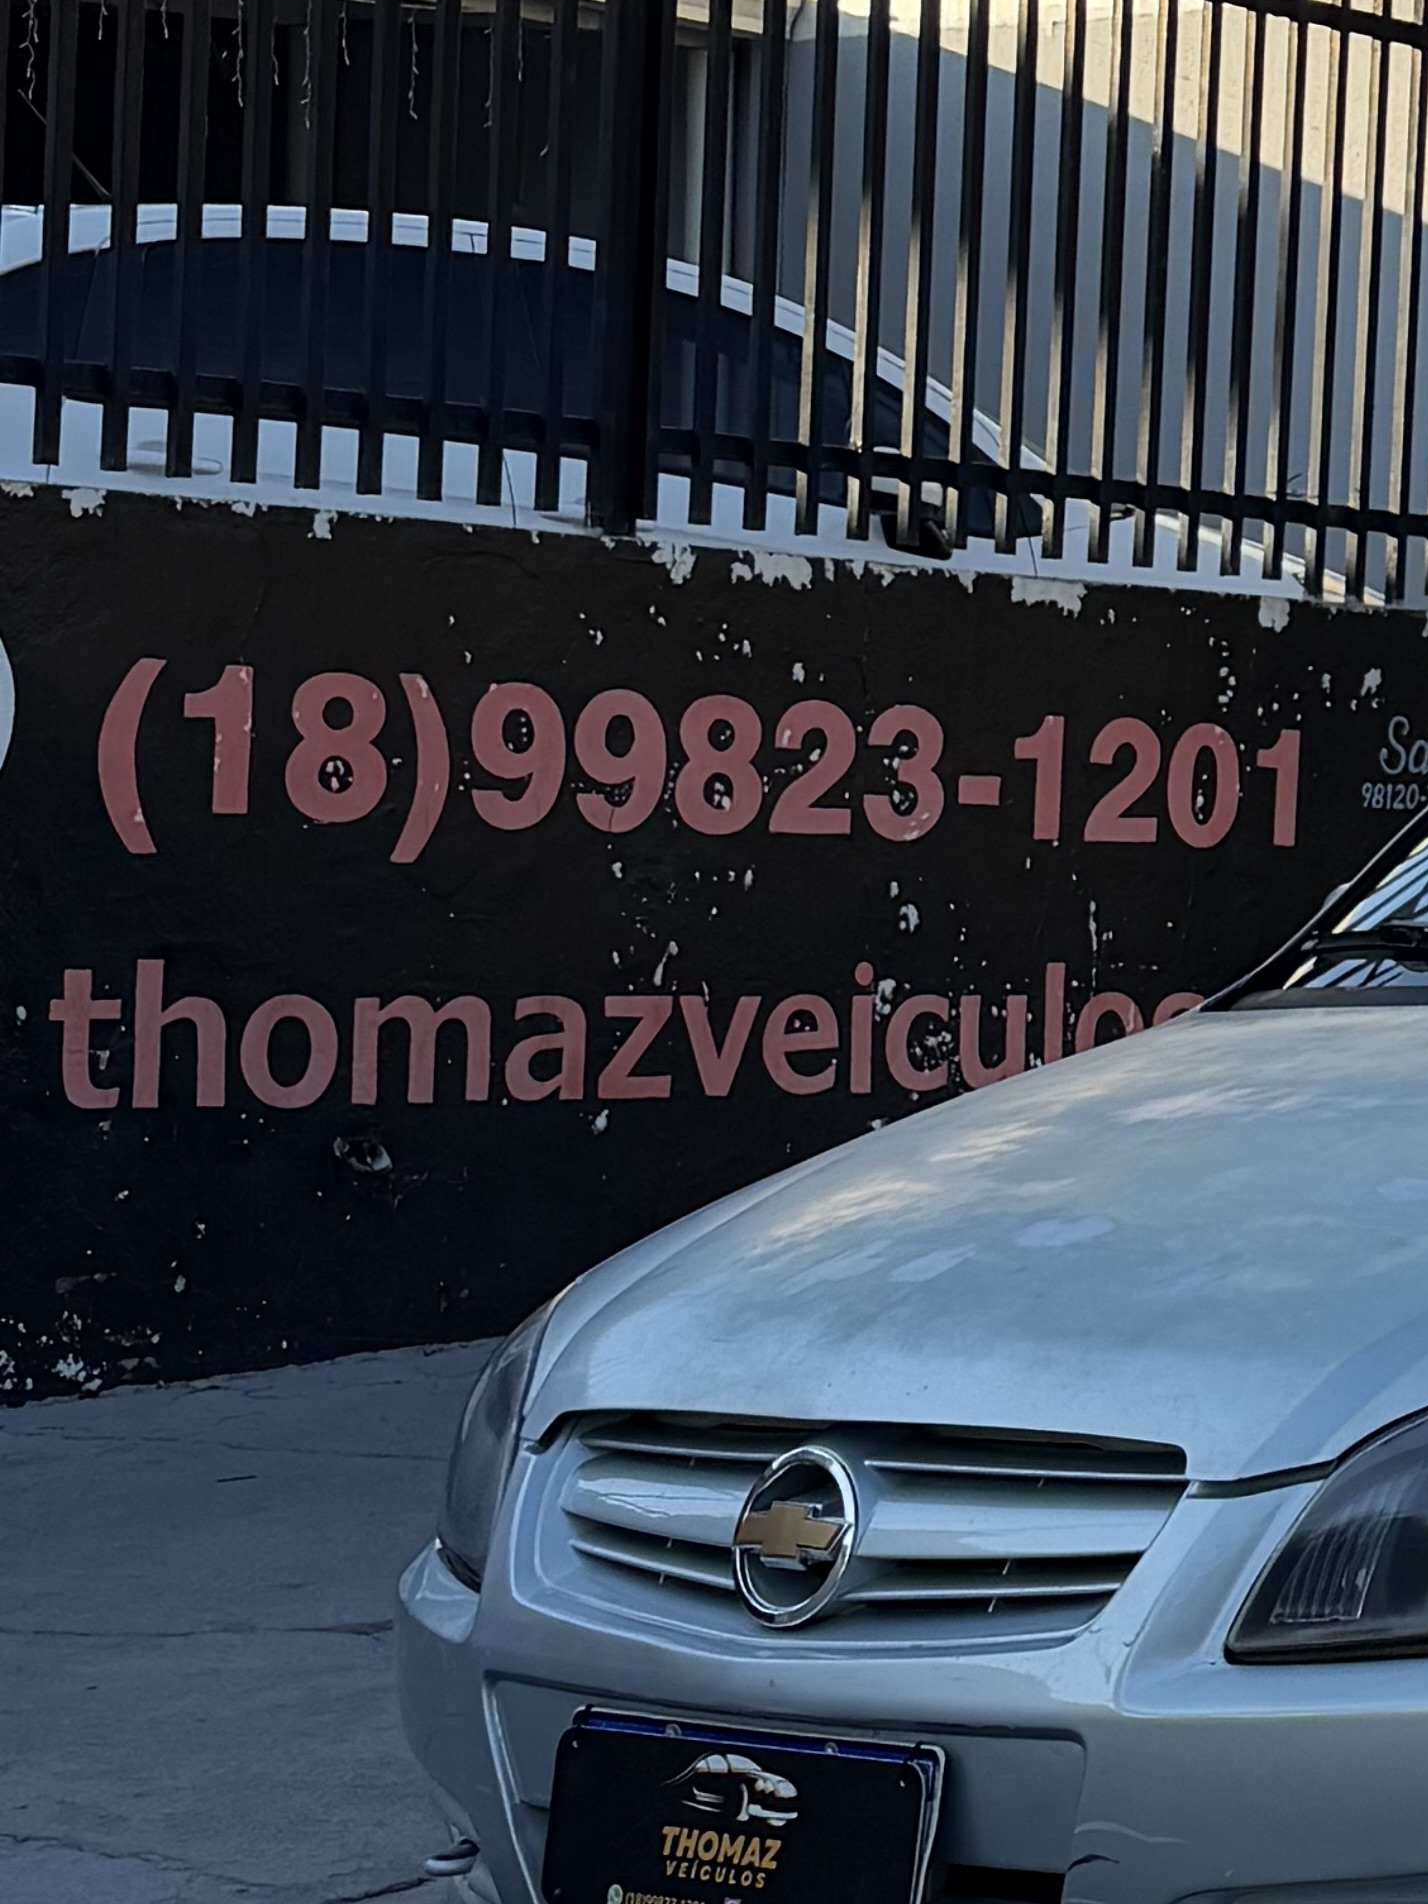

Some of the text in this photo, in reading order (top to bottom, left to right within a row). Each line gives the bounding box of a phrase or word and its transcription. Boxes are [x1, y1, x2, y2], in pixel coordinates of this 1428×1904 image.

[97, 658, 1303, 863] (18)99823-1201
[662, 1826, 782, 1870] THOMAZ
[665, 1859, 766, 1889] VEÍCULOS
